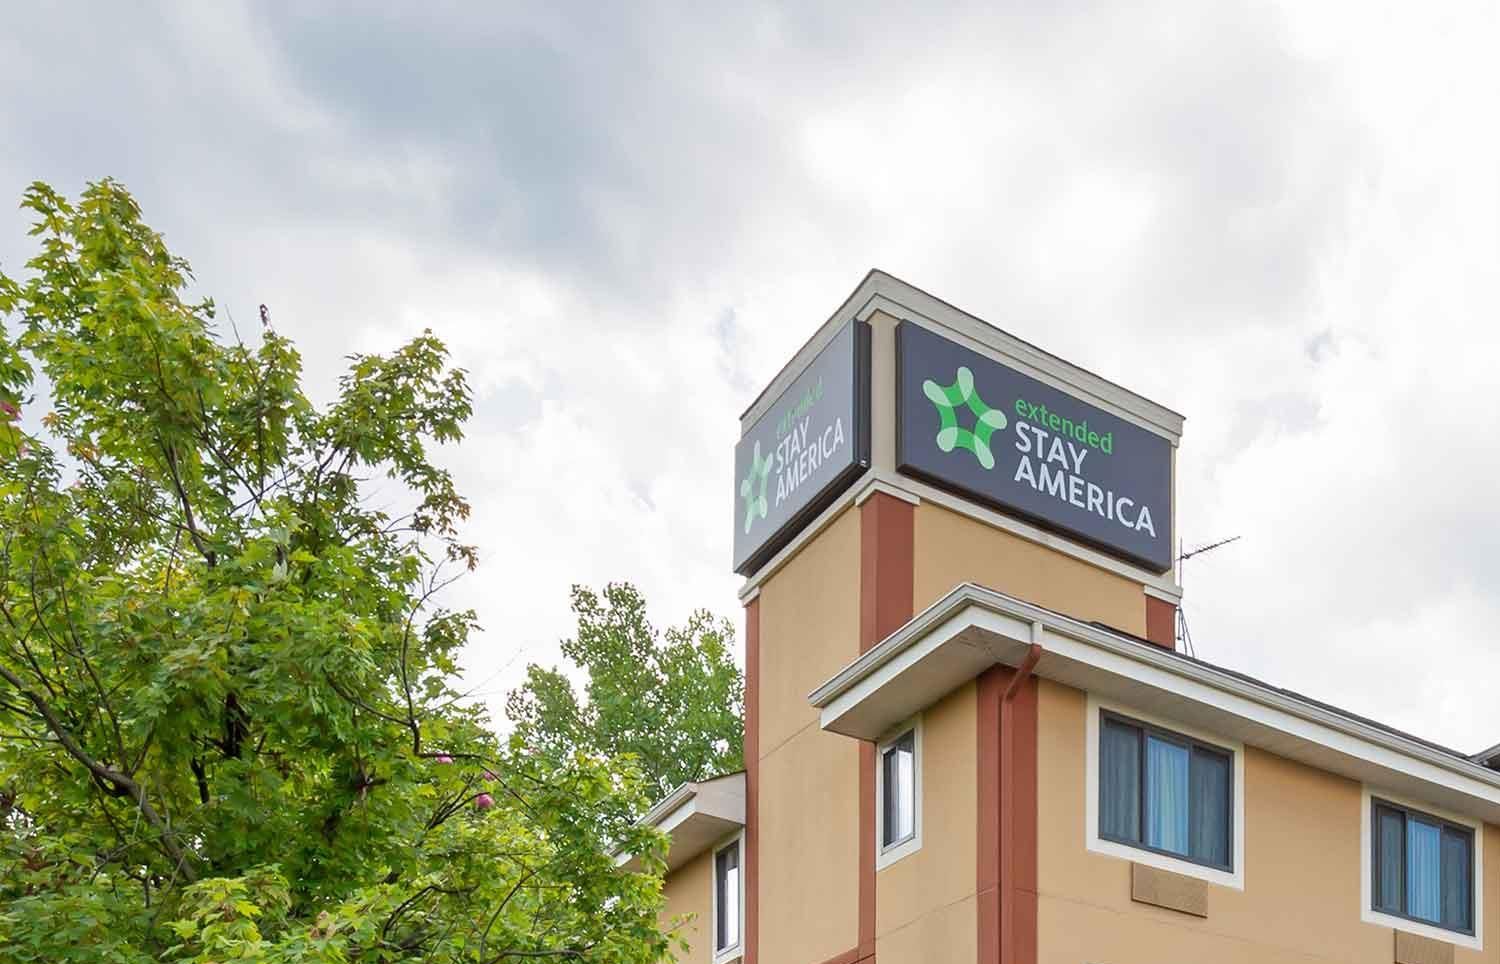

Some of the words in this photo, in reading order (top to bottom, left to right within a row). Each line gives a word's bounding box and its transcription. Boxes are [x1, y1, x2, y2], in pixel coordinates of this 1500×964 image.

[776, 415, 810, 474] STAY
[1015, 399, 1113, 454] extended
[1015, 421, 1088, 475] STAY
[775, 417, 844, 507] AMERICA
[1014, 455, 1157, 538] AMERICA
